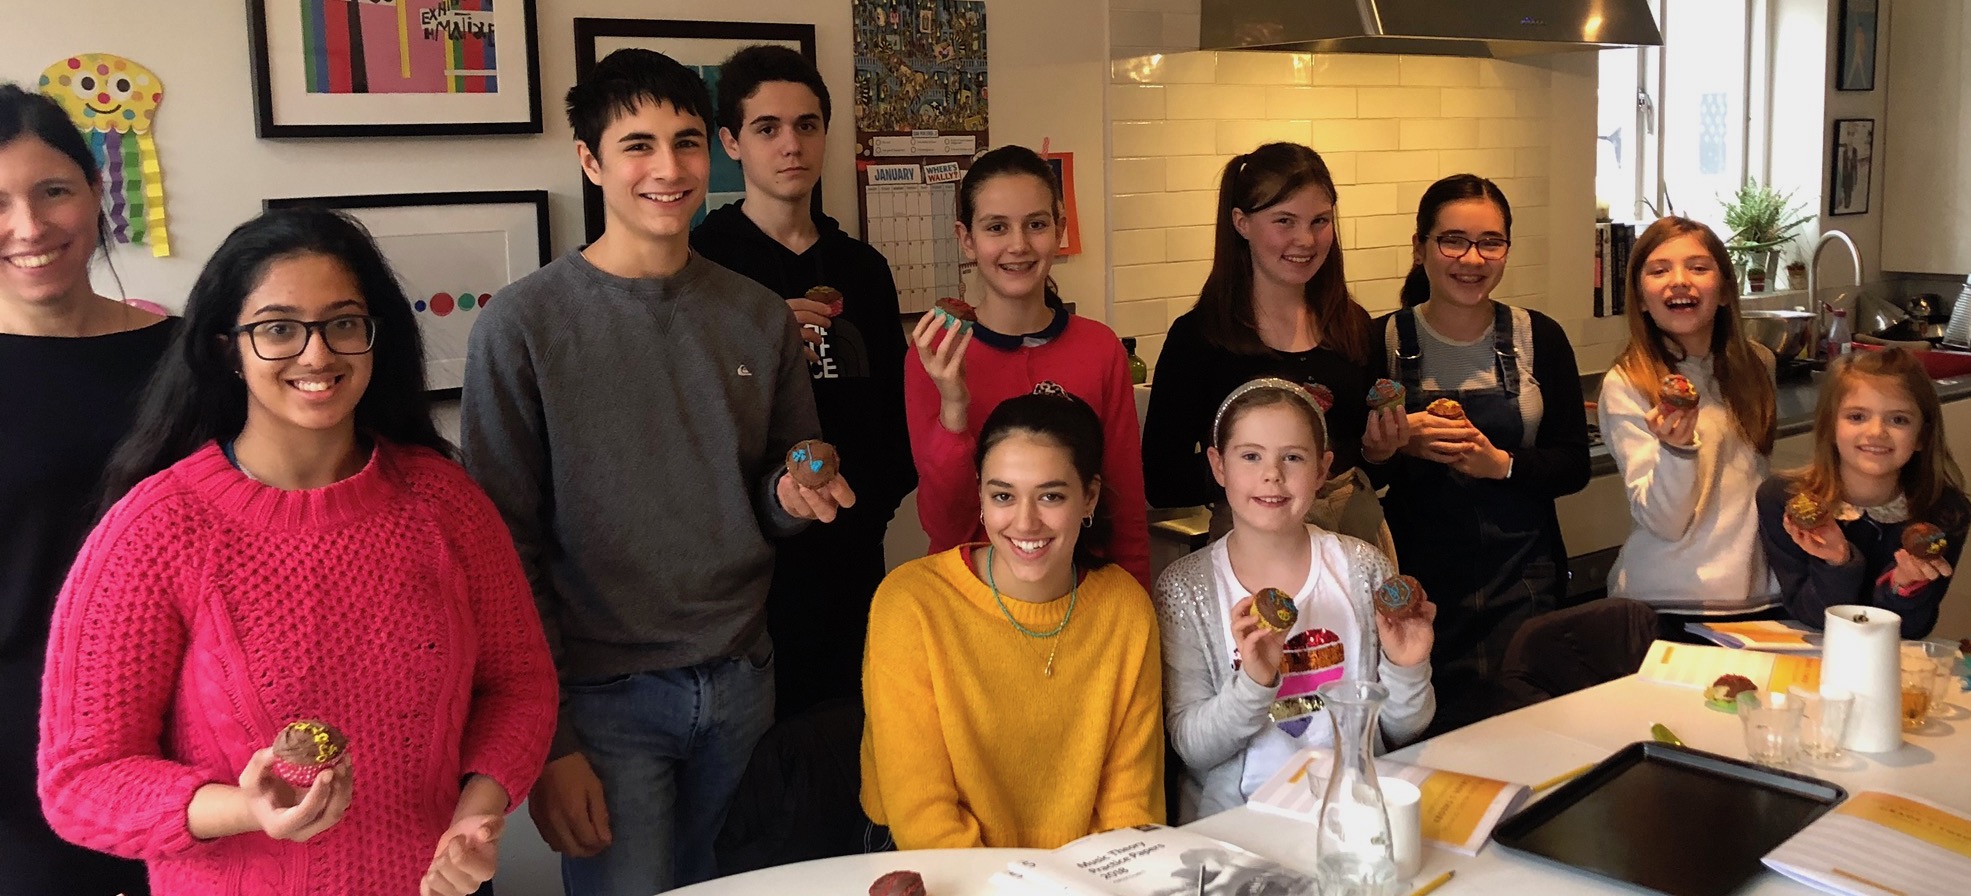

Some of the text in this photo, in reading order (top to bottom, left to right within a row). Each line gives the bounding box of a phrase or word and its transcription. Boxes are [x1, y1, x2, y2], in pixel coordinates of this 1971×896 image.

[874, 168, 914, 181] JANUARY
[926, 164, 958, 174] WHERE'S
[928, 172, 959, 182] WALLY?
[1077, 841, 1146, 869] Music Theory
[1088, 843, 1166, 873] Practice Papers
[1100, 866, 1129, 880] 2018
